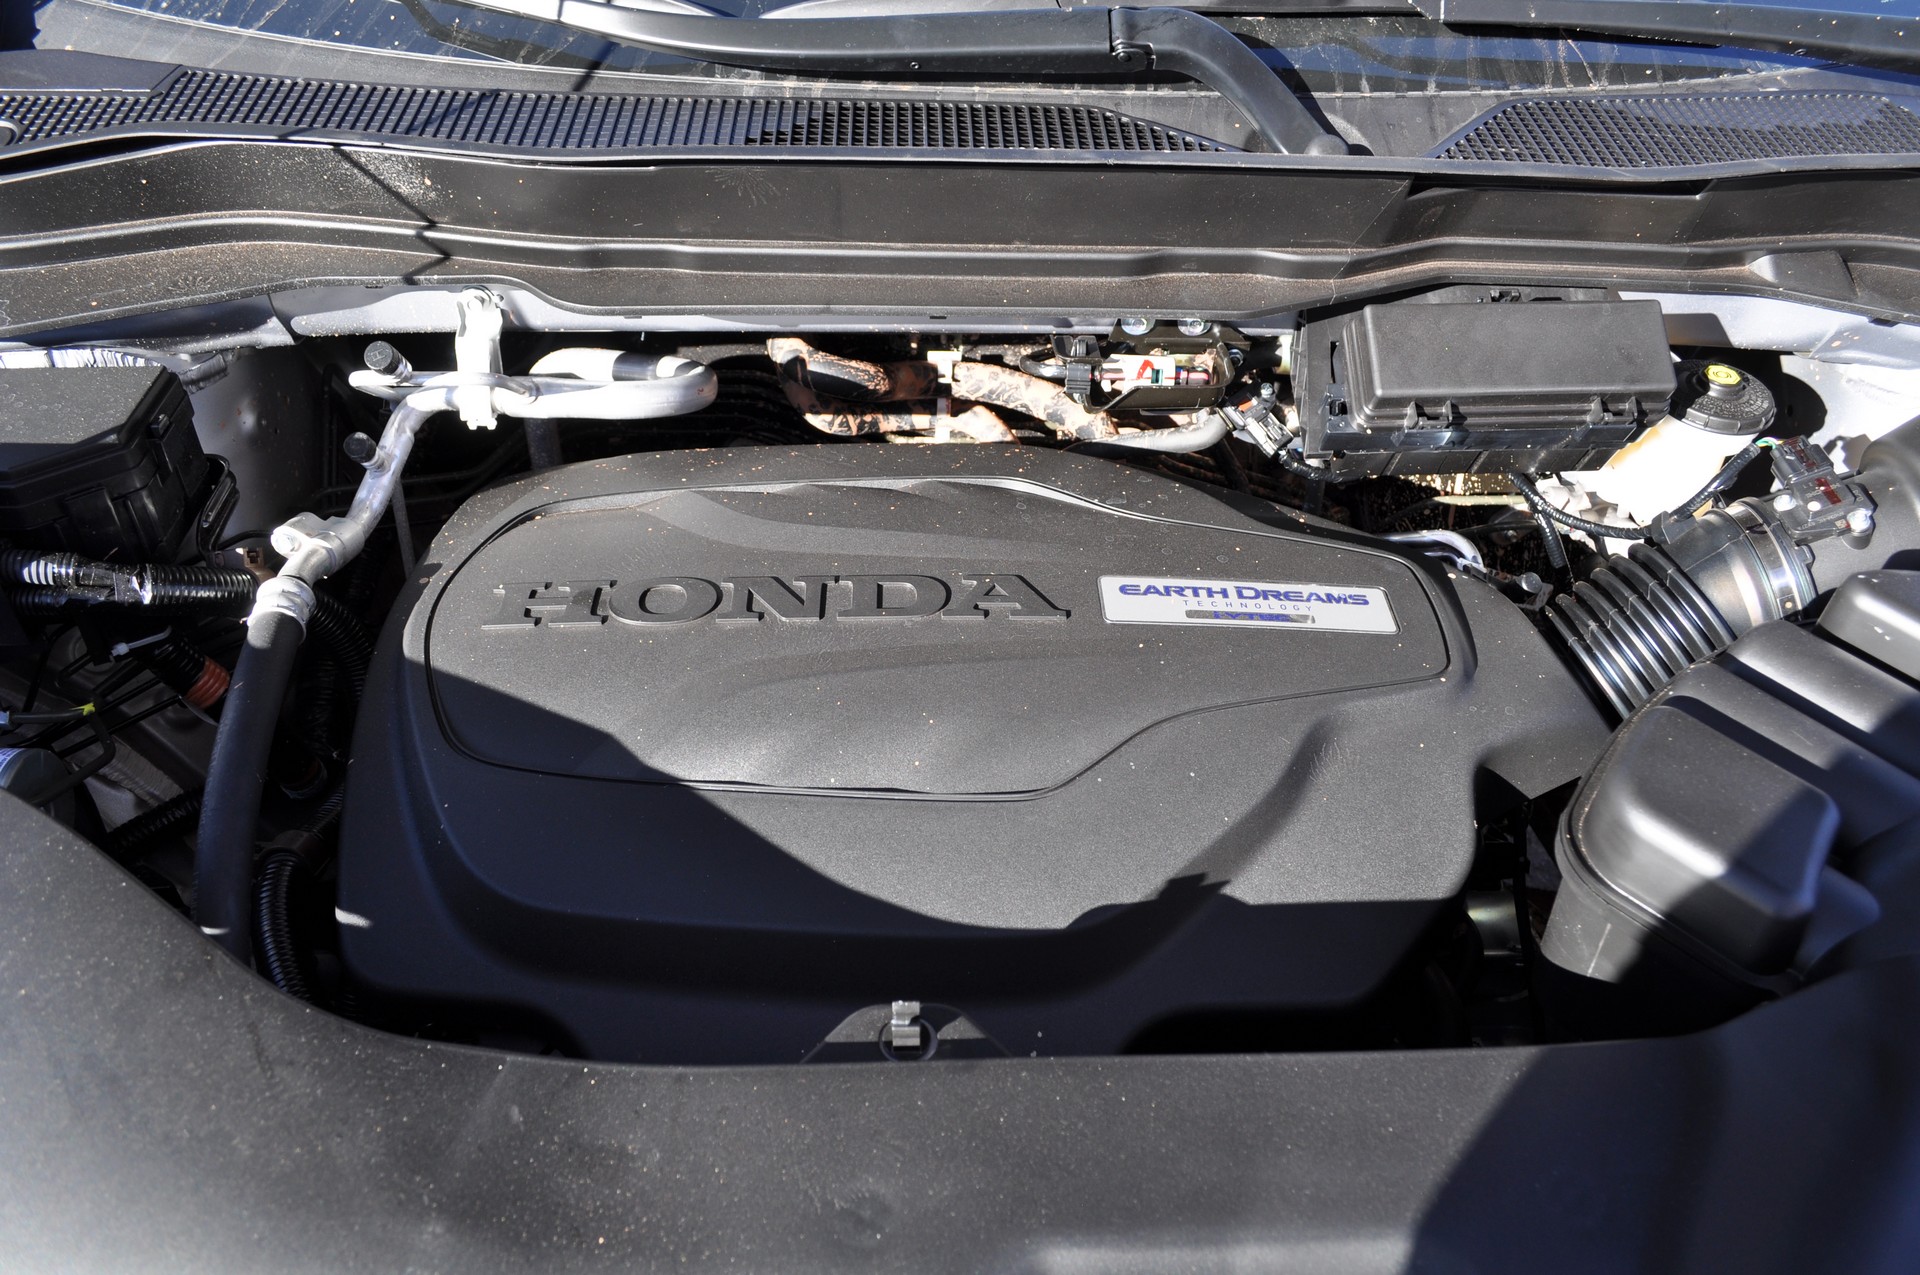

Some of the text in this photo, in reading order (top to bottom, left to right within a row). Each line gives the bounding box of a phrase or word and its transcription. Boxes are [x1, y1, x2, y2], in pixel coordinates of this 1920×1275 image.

[481, 574, 1072, 630] HONDA
[1118, 583, 1369, 606] EARTH DREAMS
[1183, 600, 1312, 612] TECHNOLOGY
